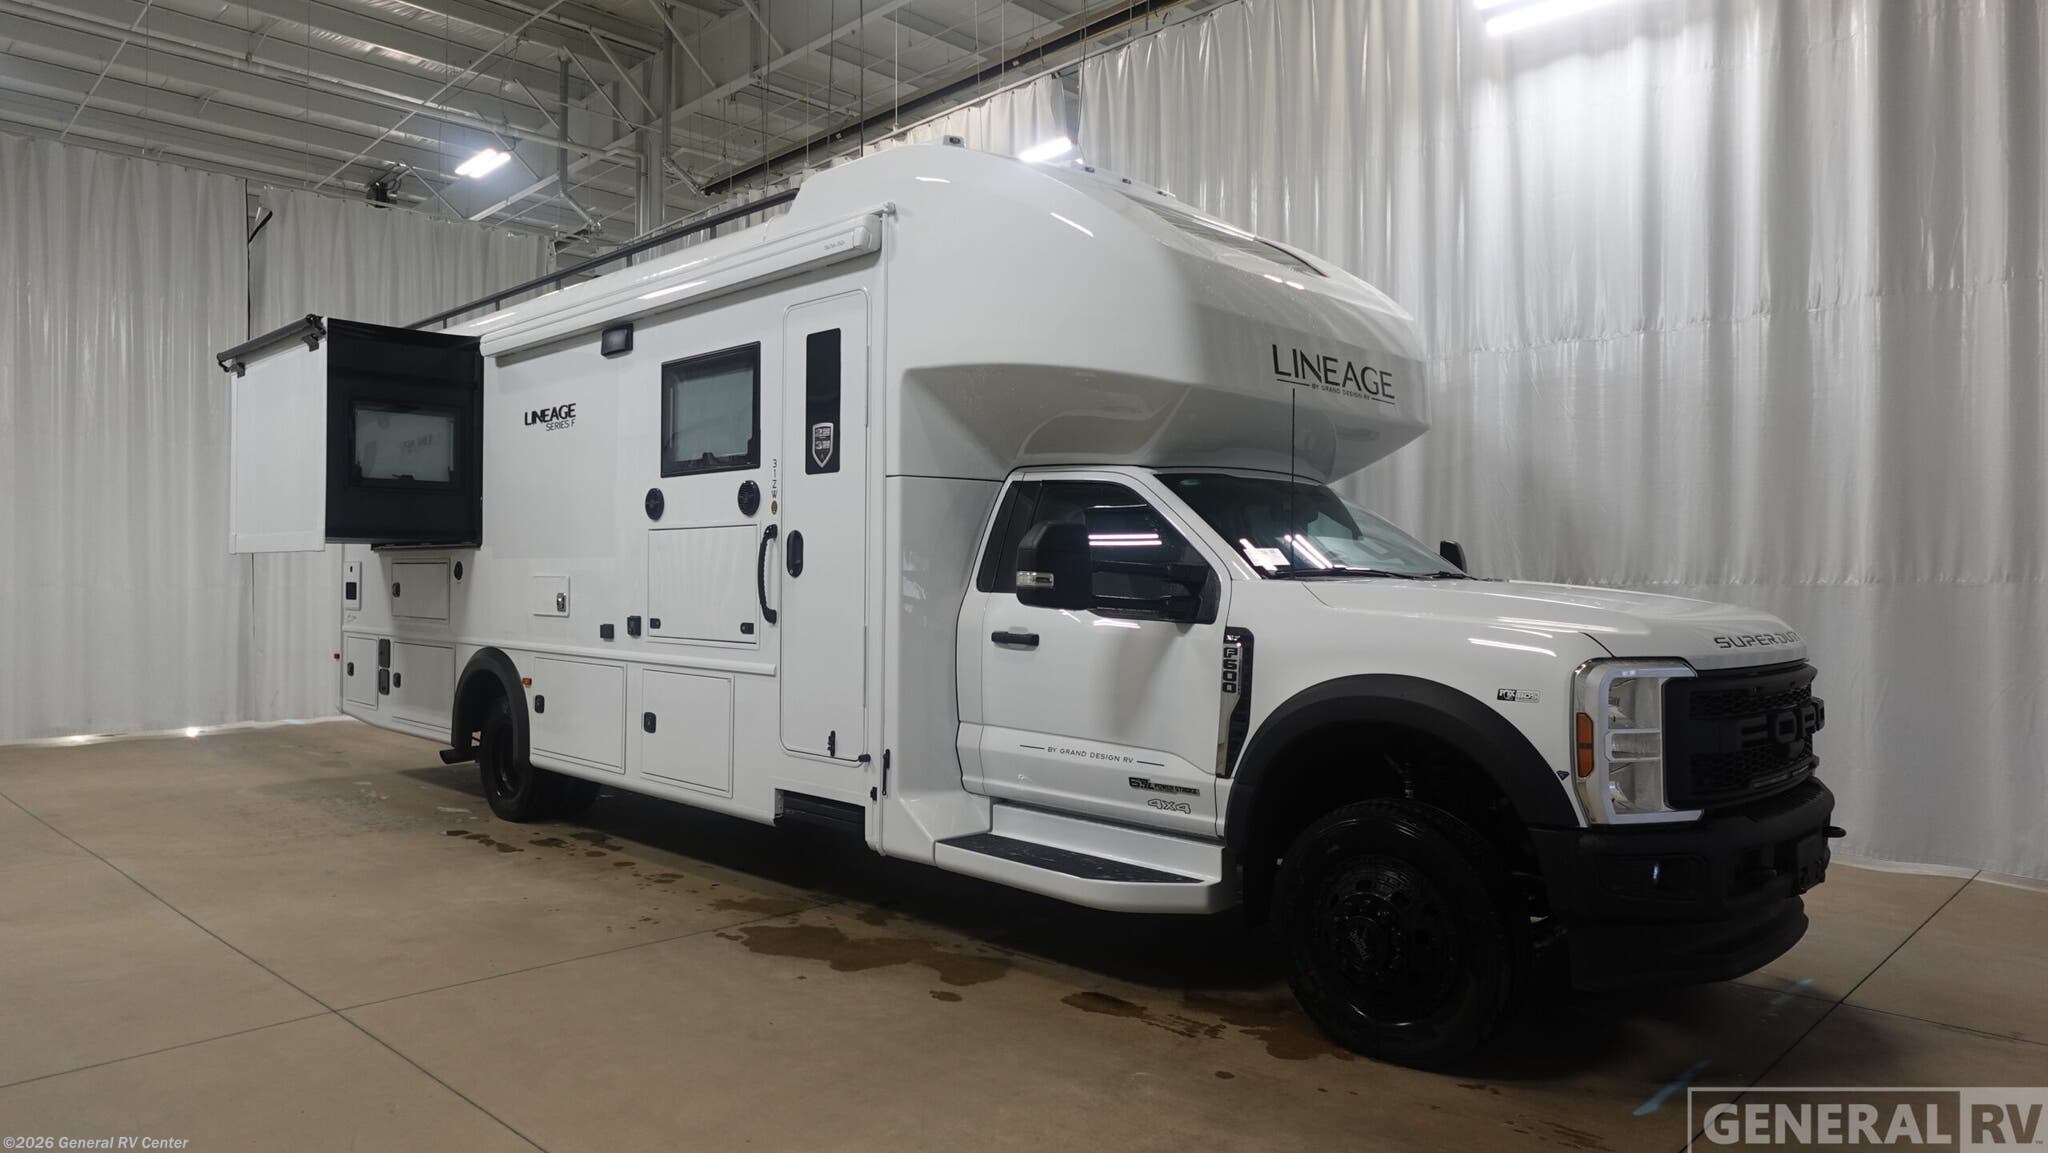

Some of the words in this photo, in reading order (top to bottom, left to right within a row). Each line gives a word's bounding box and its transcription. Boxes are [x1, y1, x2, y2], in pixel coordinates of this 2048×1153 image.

[1272, 344, 1395, 399] LINEAGE
[524, 402, 577, 426] LINEAGE
[545, 420, 570, 431] SERIES
[570, 418, 576, 427] F
[1714, 633, 1777, 648] SUPER
[1059, 748, 1087, 758] GRAND
[1089, 751, 1121, 762] DESIGN
[1122, 756, 1134, 764] RV
